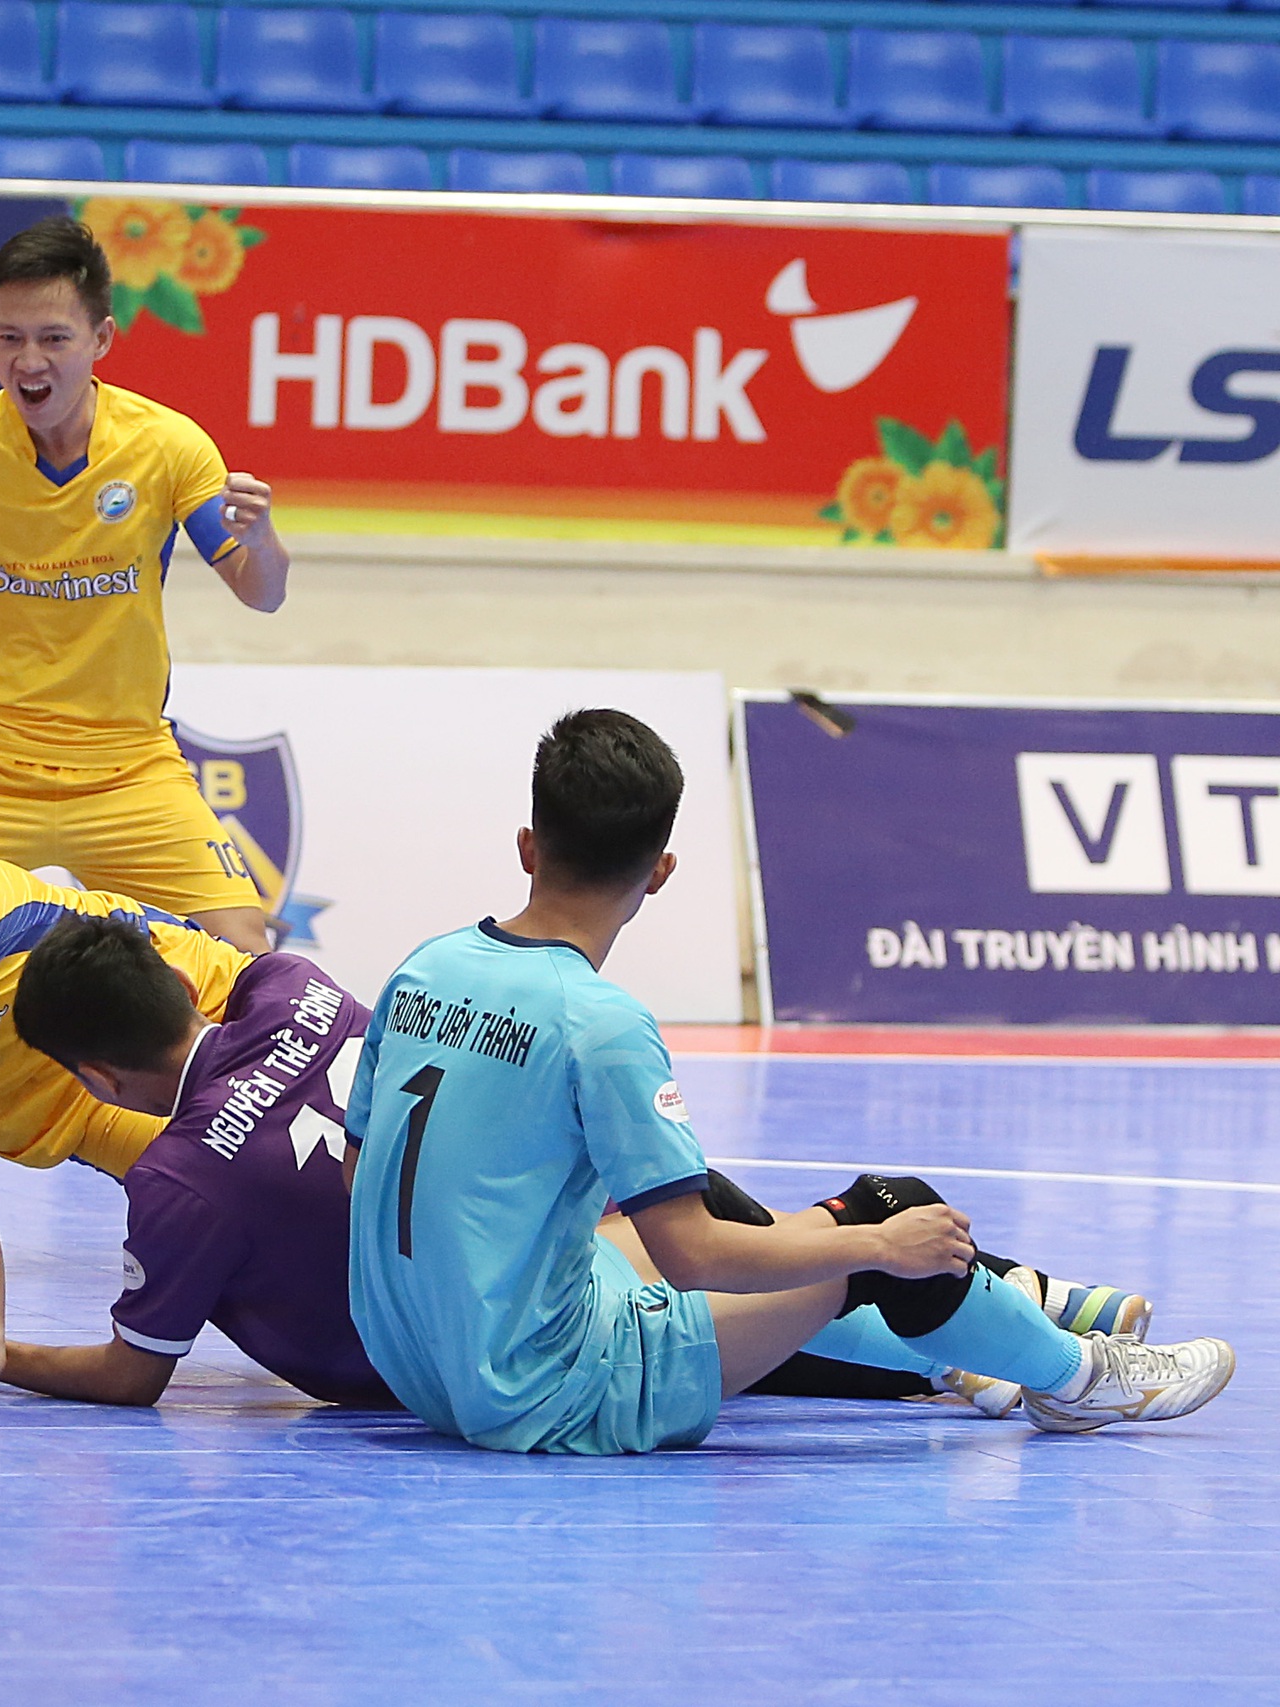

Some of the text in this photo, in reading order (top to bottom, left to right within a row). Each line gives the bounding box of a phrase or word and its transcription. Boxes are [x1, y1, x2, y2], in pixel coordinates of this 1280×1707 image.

[248, 312, 769, 443] HDBank
[1074, 345, 1280, 464] LS
[1049, 780, 1280, 868] VT
[867, 919, 948, 969] ĐÀI
[951, 920, 1136, 972] TRUYỀN
[1142, 922, 1260, 973] HÌNH
[398, 1063, 446, 1261] 1
